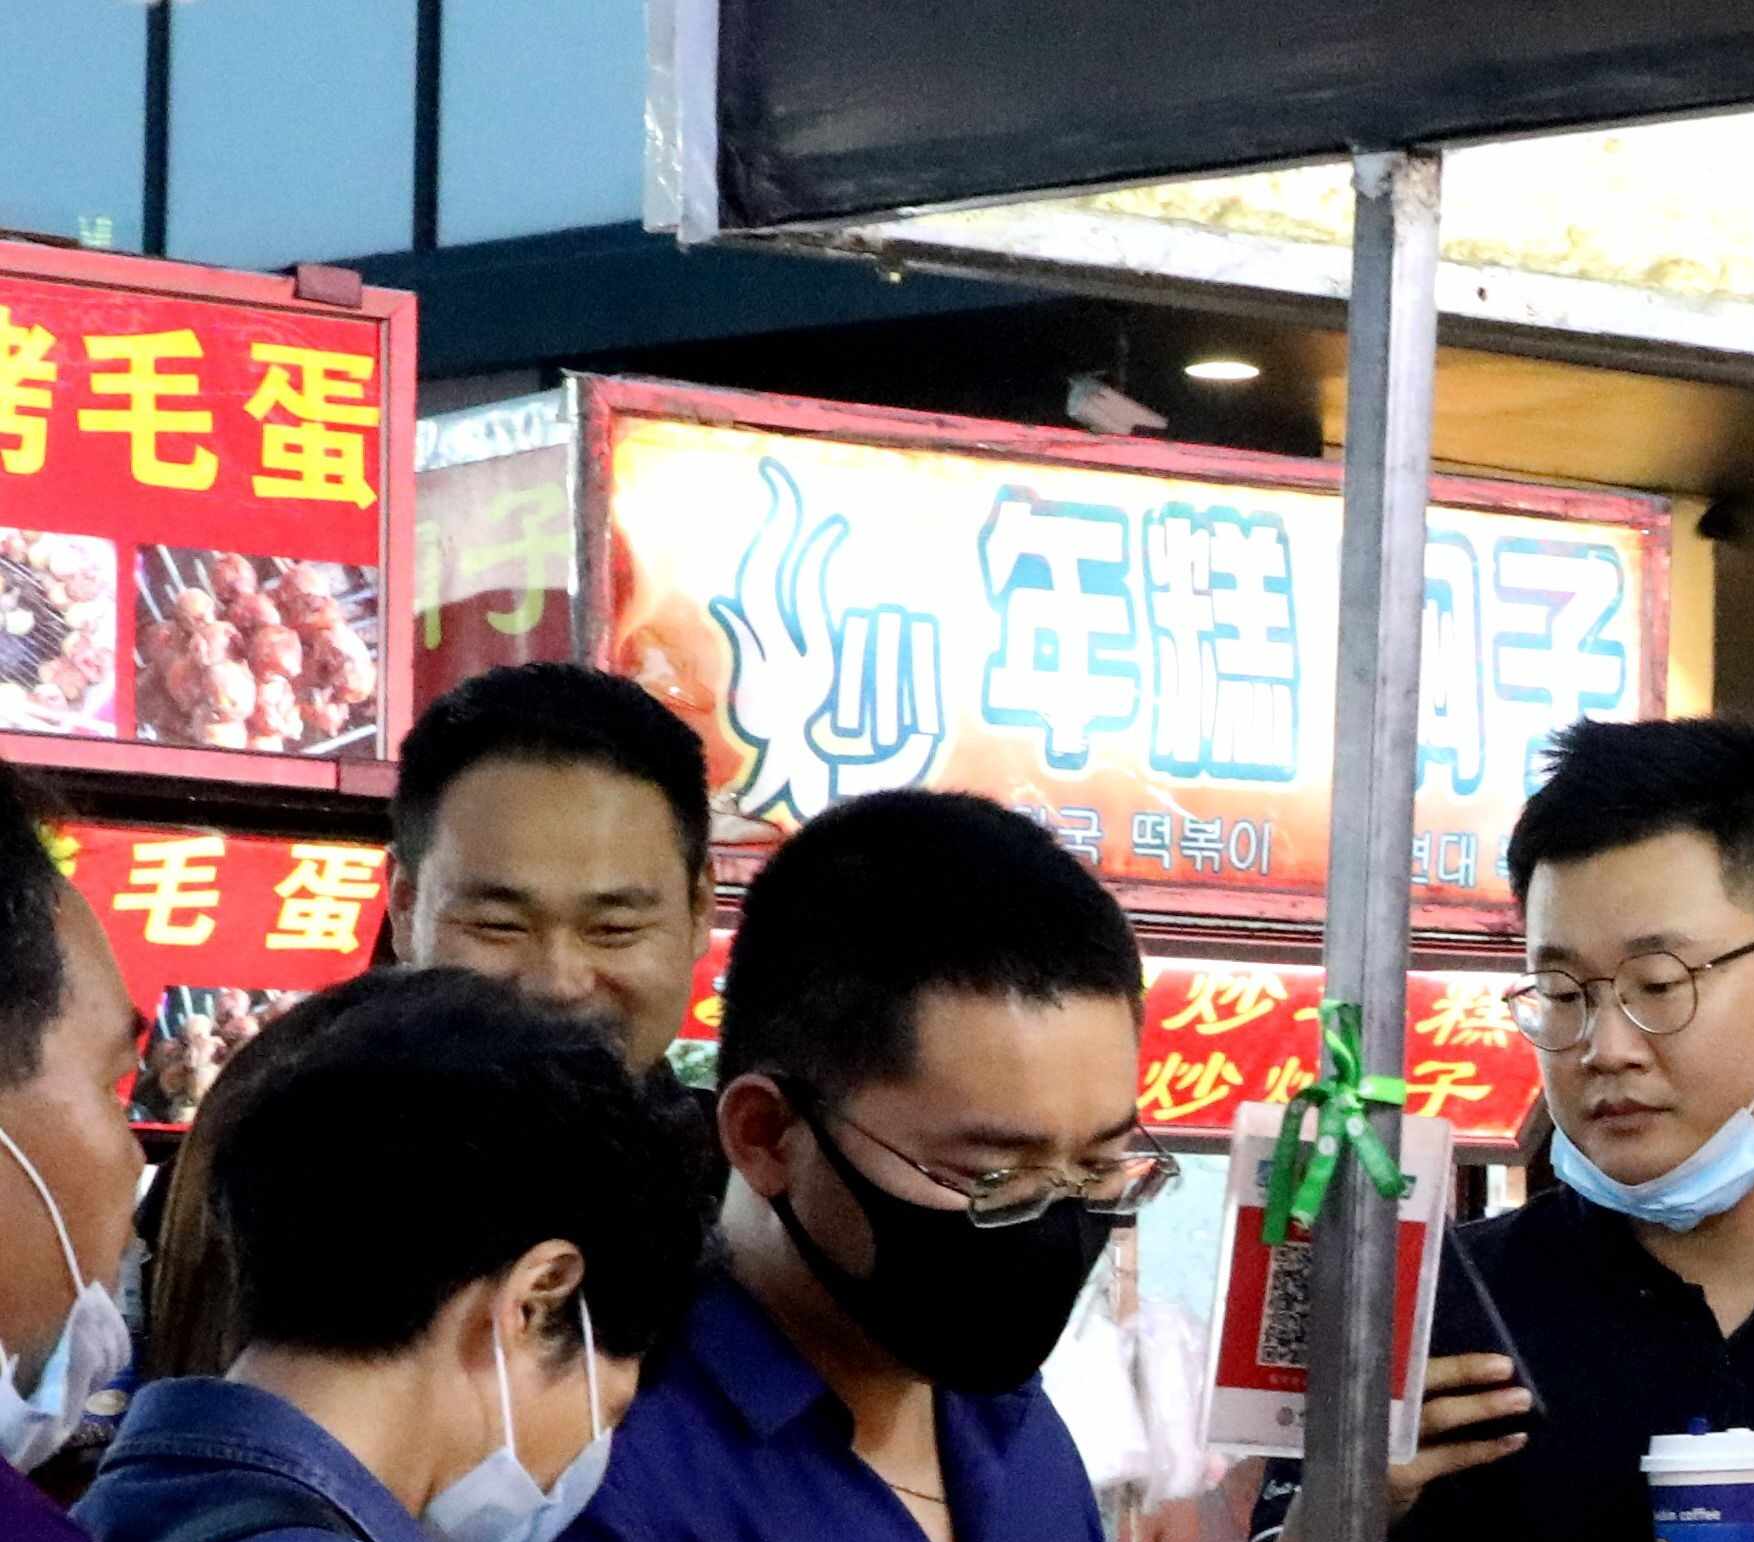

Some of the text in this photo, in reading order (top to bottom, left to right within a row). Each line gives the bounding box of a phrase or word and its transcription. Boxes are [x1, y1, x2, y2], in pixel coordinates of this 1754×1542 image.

[1131, 811, 1273, 876] 떡볶이
[37, 822, 384, 955] 毛蛋
[1679, 1507, 1722, 1521] coffee
